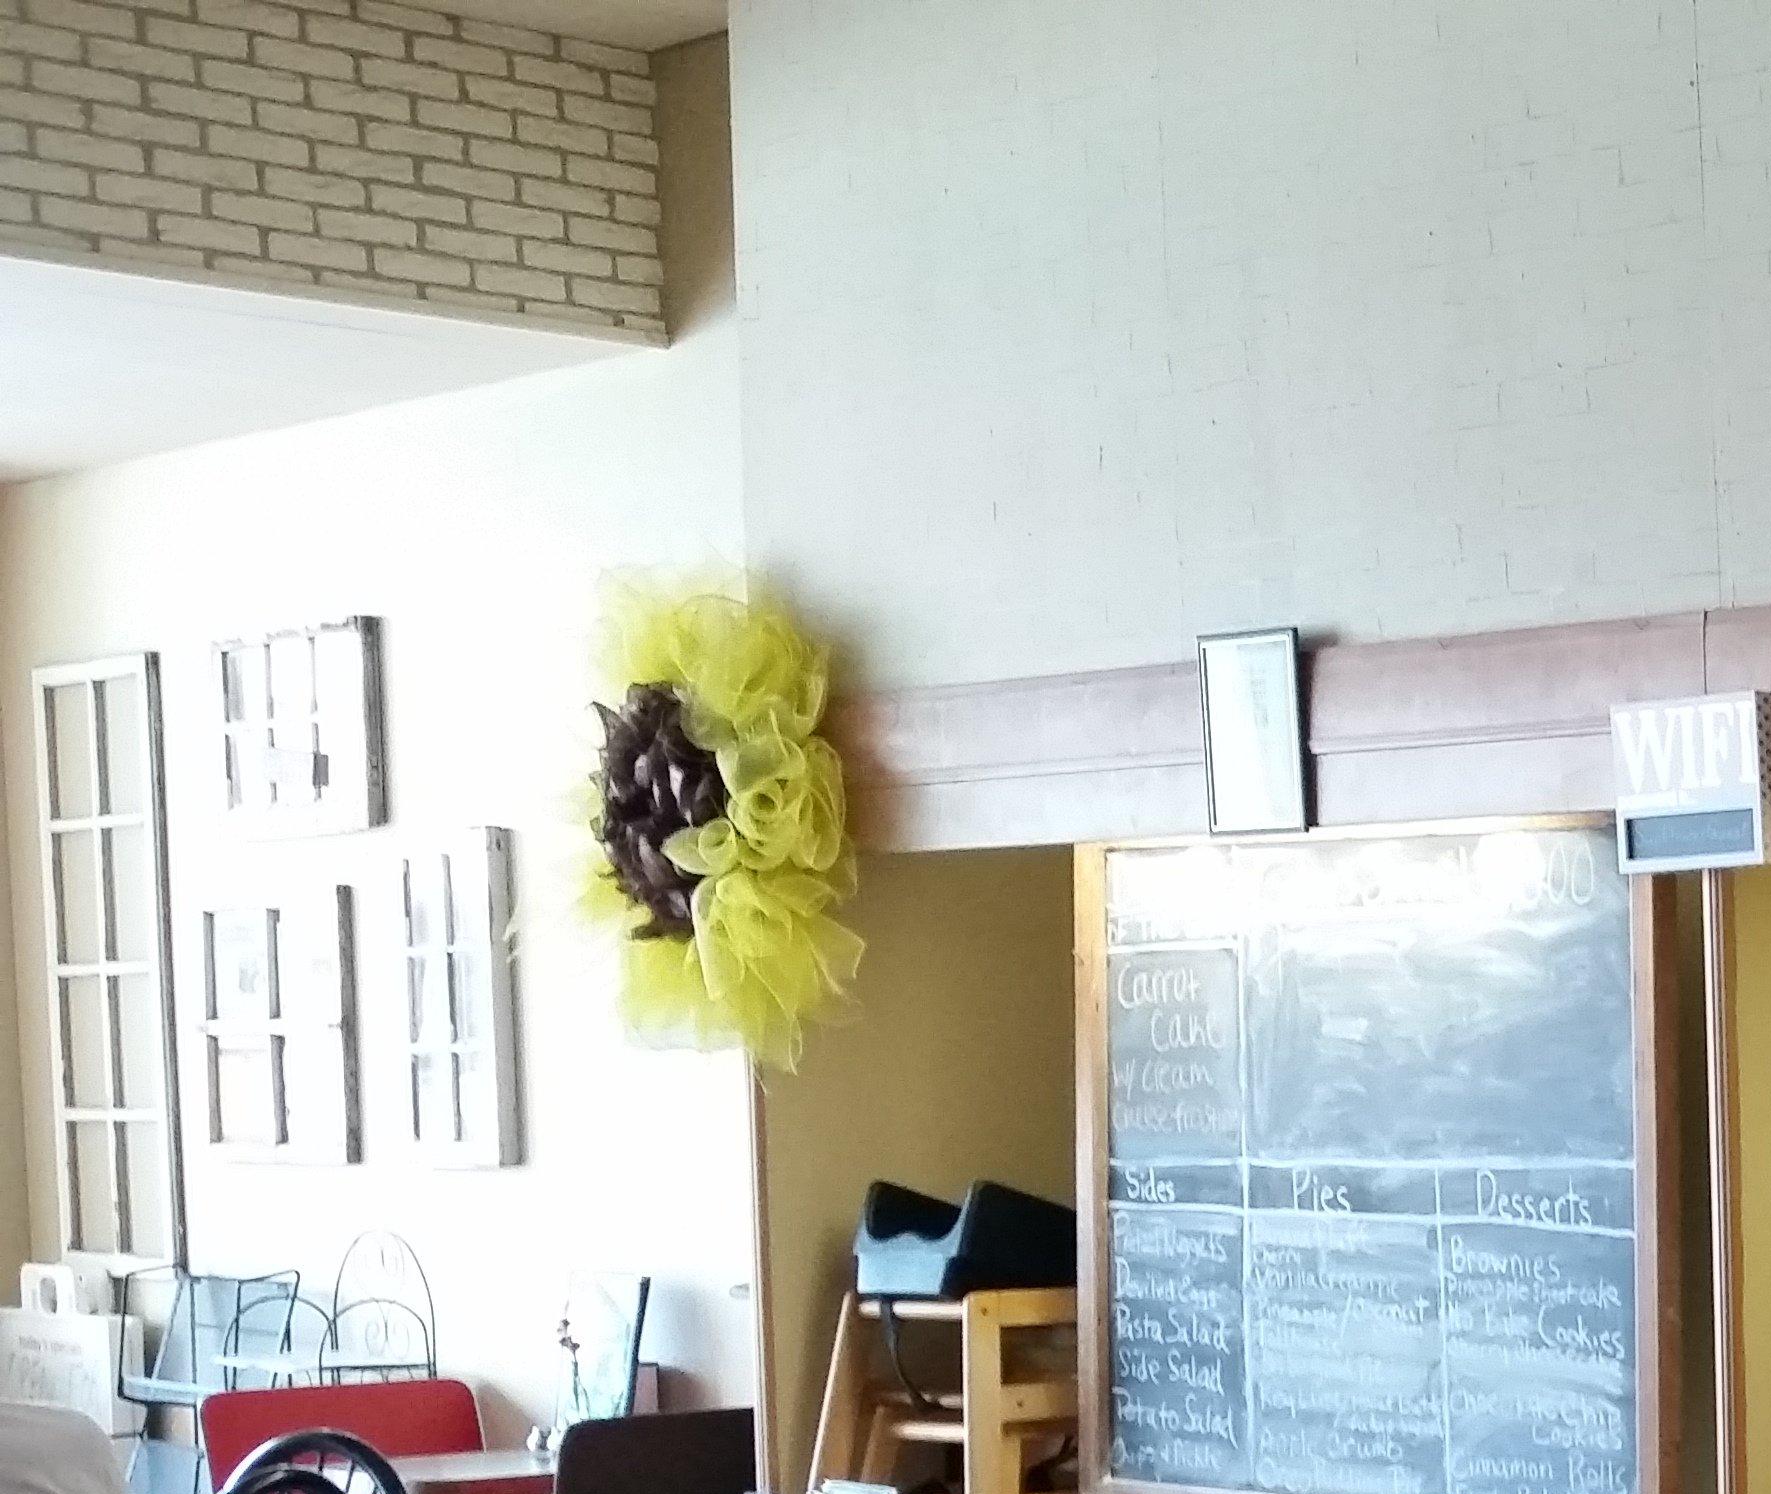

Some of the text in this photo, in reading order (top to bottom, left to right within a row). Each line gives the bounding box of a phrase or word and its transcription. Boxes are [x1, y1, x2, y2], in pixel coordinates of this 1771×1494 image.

[1613, 700, 1757, 794] WIFI
[1117, 960, 1200, 1010] Carrot
[1124, 1166, 1176, 1204] Sides
[1291, 1167, 1353, 1216] Pies
[1476, 1169, 1593, 1226] Desserts
[1450, 1234, 1561, 1284] Brownies
[1115, 1302, 1163, 1344] Pasta
[1165, 1307, 1230, 1356] Salad
[1537, 1304, 1626, 1360] Cookies
[1118, 1345, 1160, 1386] Side
[1167, 1349, 1225, 1398] Salad
[1111, 1385, 1239, 1450] Potato Salad
[1449, 1445, 1554, 1481] Cinnamon
